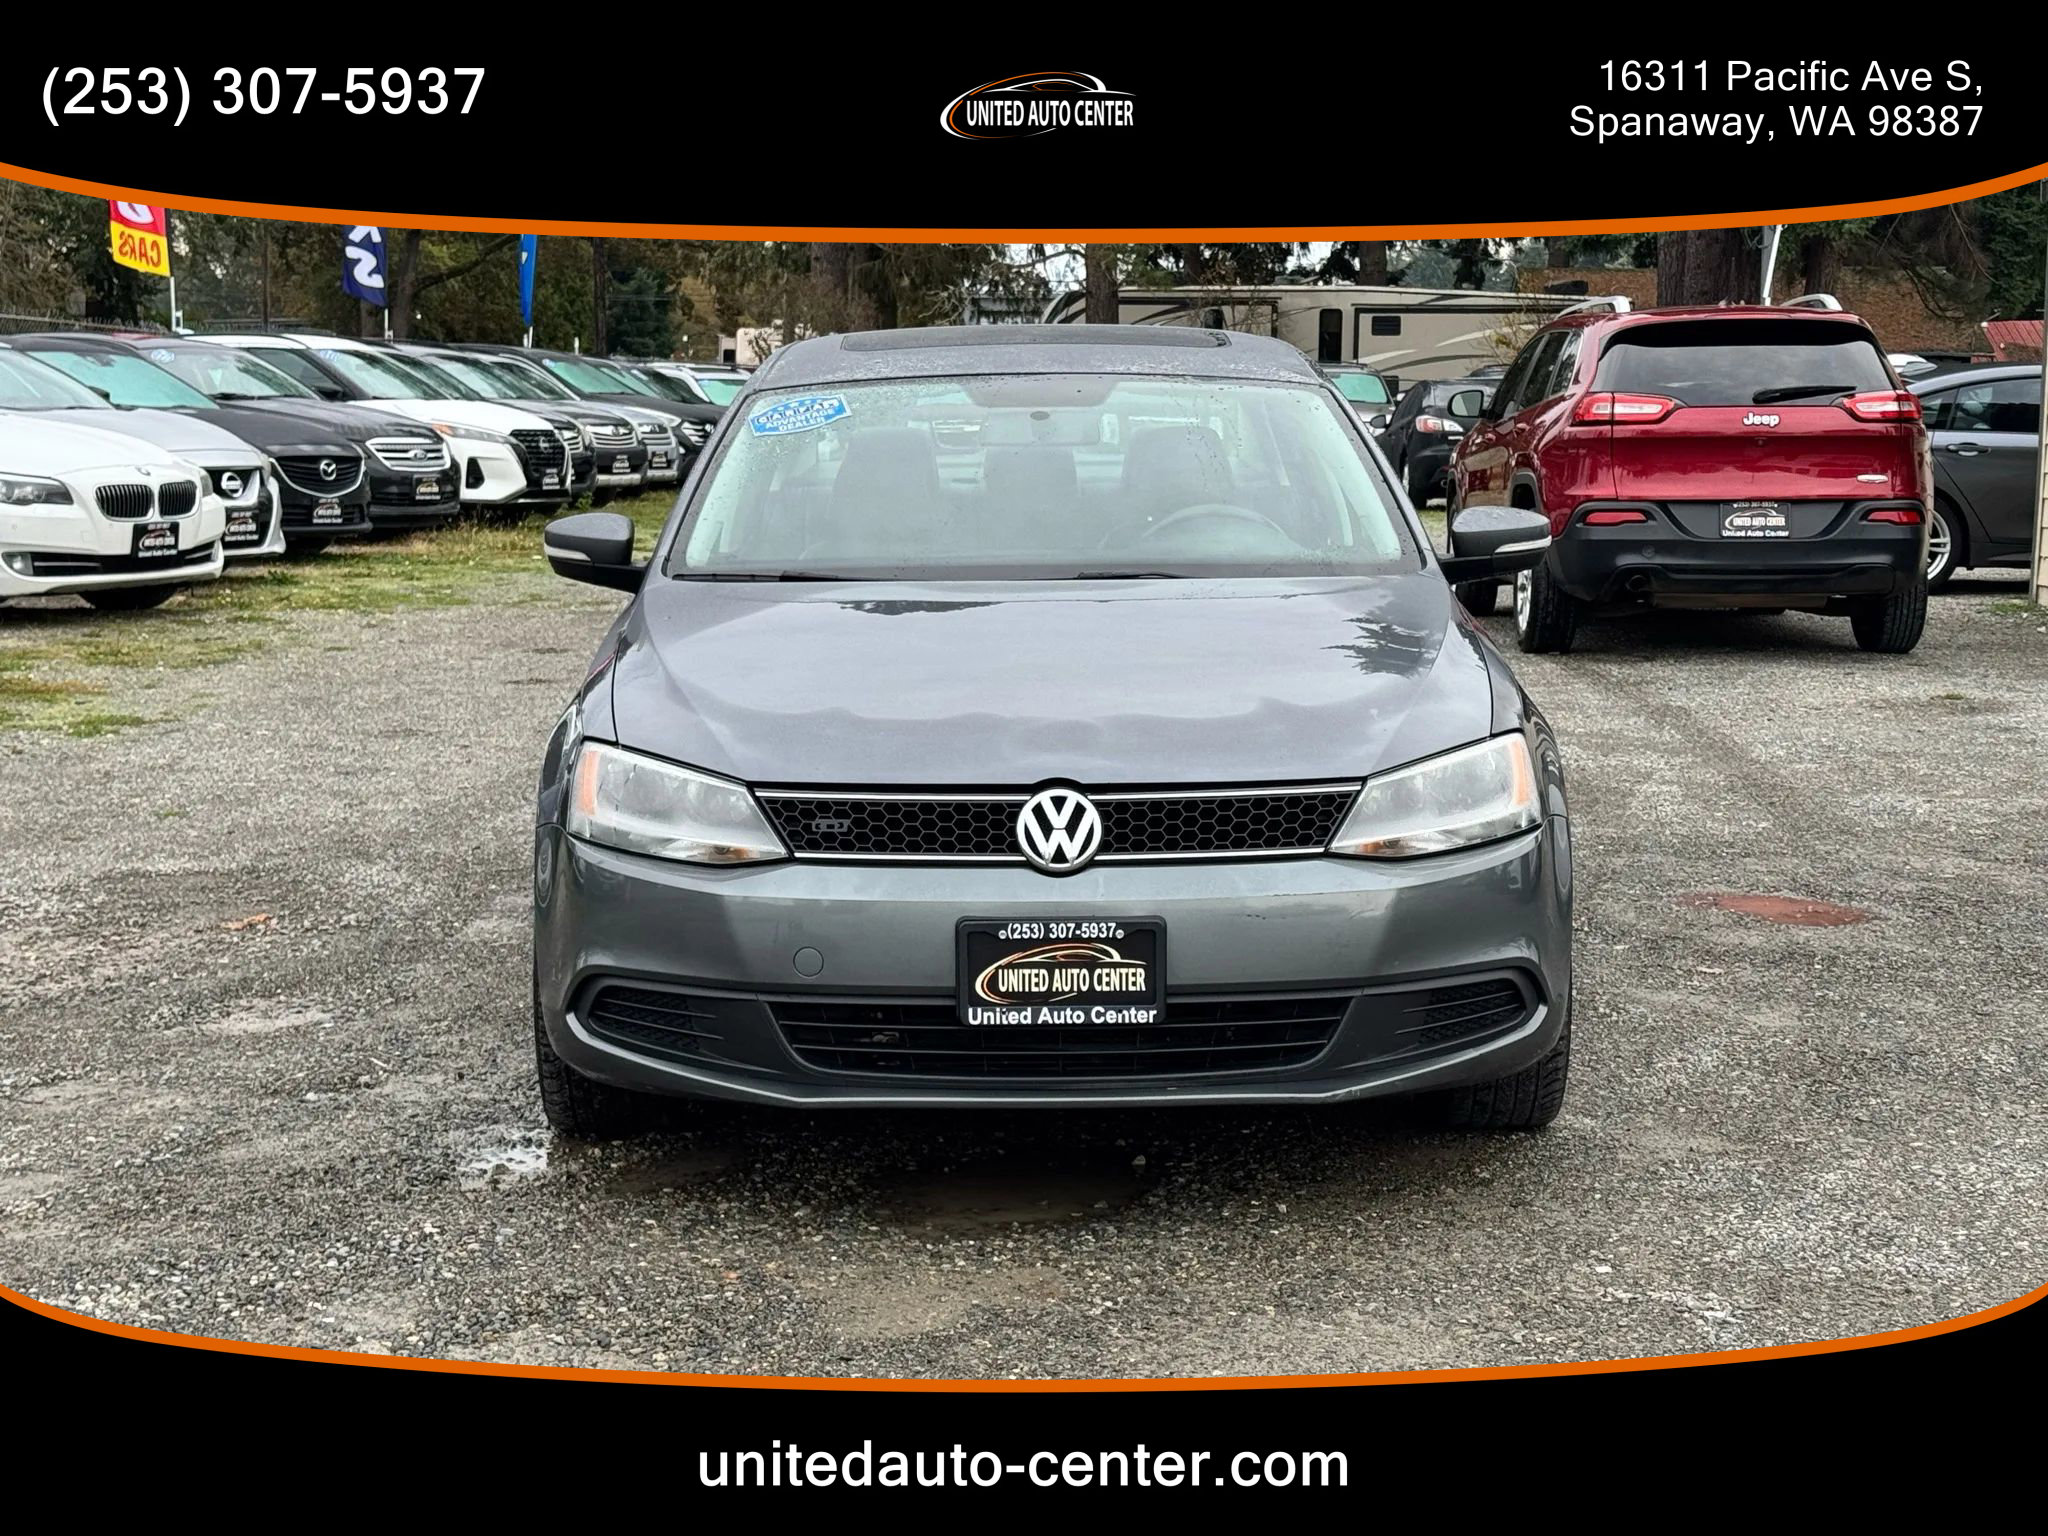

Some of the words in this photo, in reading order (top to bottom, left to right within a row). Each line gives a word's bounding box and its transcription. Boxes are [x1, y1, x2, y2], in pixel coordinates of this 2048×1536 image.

[766, 409, 835, 429] ADVANTAGE
[779, 417, 825, 432] DEALER
[1743, 412, 1780, 427] Jeep
[1747, 529, 1764, 537] Auto
[1007, 922, 1045, 940] (253)
[1049, 922, 1117, 939] 307-5937
[998, 968, 1049, 992] UNITED
[1052, 968, 1090, 992] AUTO
[1093, 967, 1147, 992] CENTER
[968, 1006, 1032, 1025] United
[1038, 1006, 1085, 1025] Auto
[1091, 1006, 1157, 1024] Center
